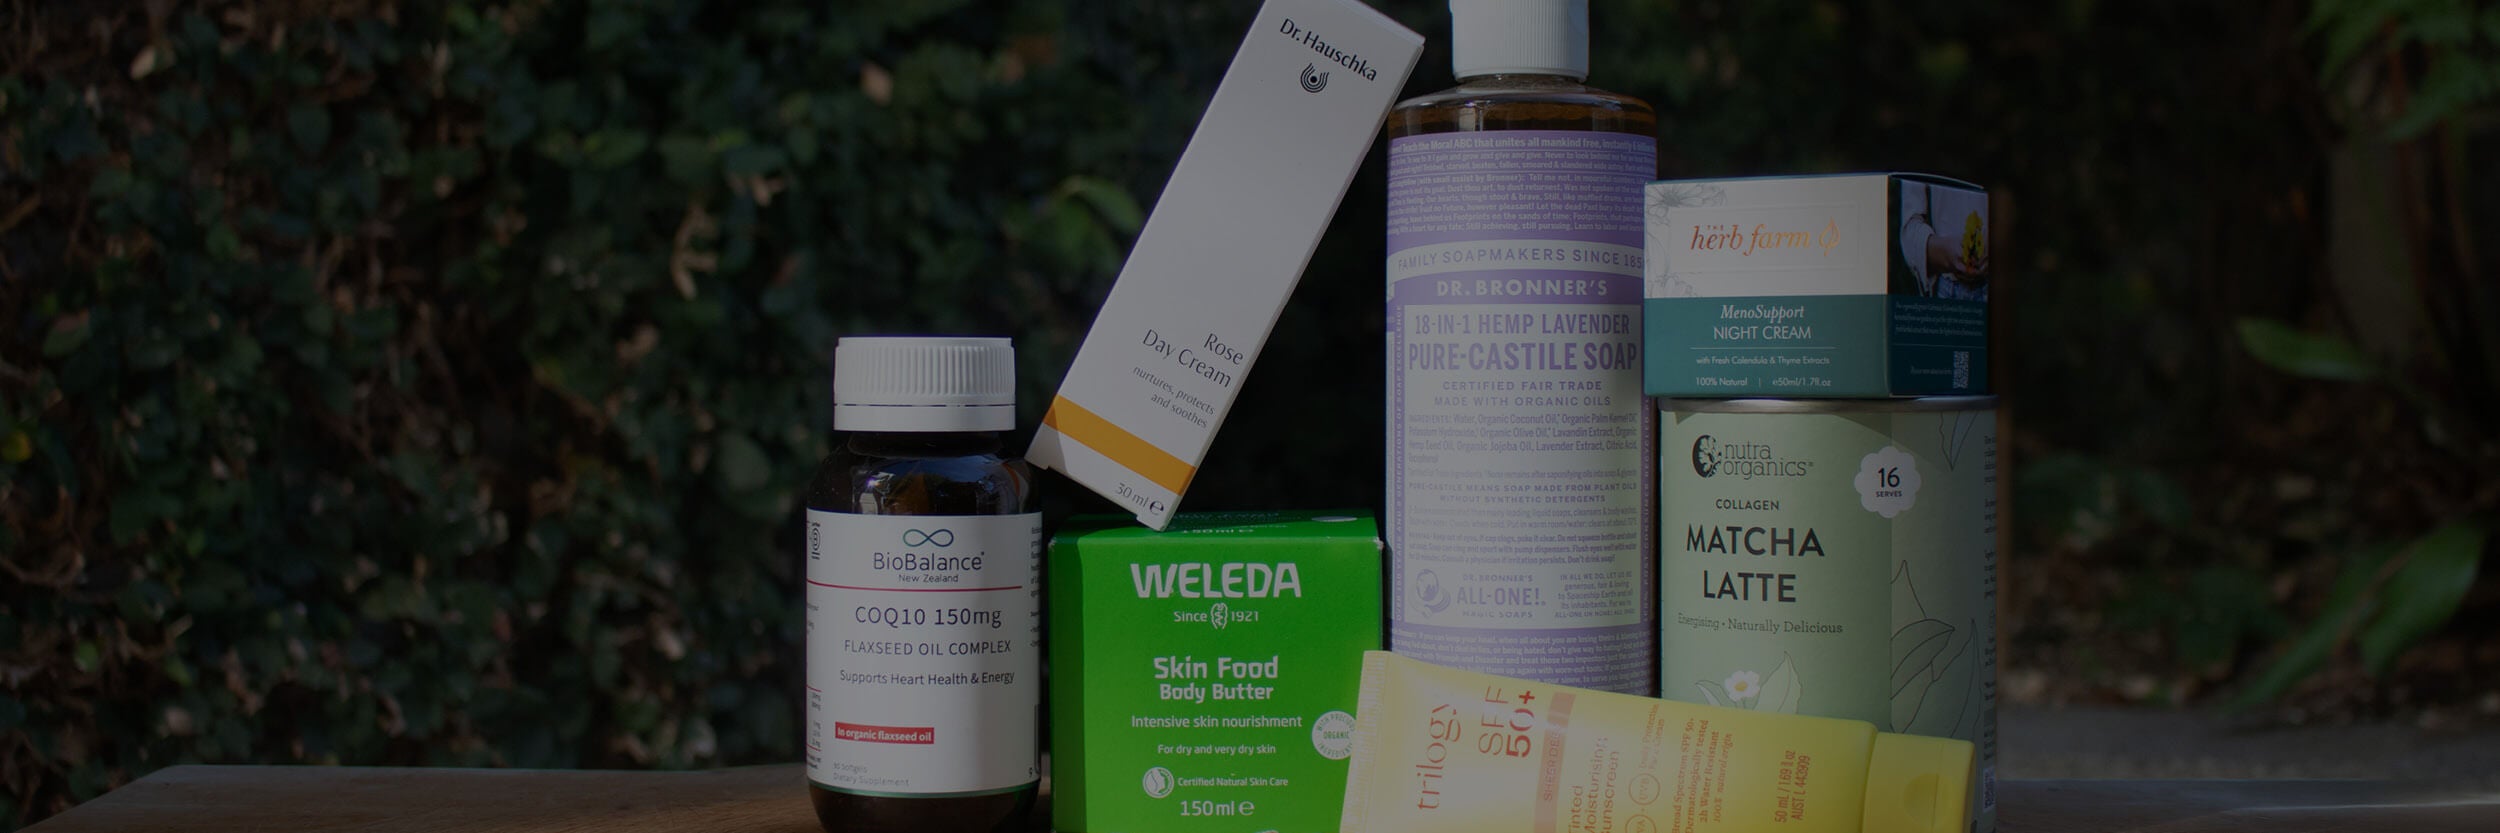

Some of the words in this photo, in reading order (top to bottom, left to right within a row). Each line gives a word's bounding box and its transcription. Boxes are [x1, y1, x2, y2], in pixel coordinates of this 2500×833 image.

[1280, 18, 1300, 41] Dr.
[1303, 31, 1377, 81] Hauschka
[1690, 224, 1744, 250] herb
[1742, 223, 1811, 256] farm
[1398, 252, 1438, 271] FAMILY
[1442, 248, 1566, 264] SOAPMAKERS
[1572, 249, 1619, 265] SINCE
[1624, 253, 1643, 269] 185
[1436, 280, 1470, 297] DR.
[1720, 304, 1804, 324] MenoSupport
[1415, 314, 1471, 335] 18-IN-1
[1479, 314, 1534, 335] HEMP
[1542, 314, 1631, 335] LAVENDER
[1713, 326, 1758, 341] NIGHT
[1762, 326, 1812, 341] CREAM
[1143, 329, 1176, 360] Day
[1178, 348, 1232, 388] Cream
[1203, 333, 1244, 366] Rose
[1409, 342, 1578, 371] PURE-CASTILE
[1583, 342, 1638, 371] SOAP
[1711, 356, 1730, 365] Fresh
[1132, 365, 1174, 395] nurtures,
[1176, 389, 1216, 416] protects
[1442, 381, 1514, 391] CERTIFIED
[1521, 381, 1553, 391] FAIR
[1558, 381, 1603, 391] TRADE
[1696, 377, 1717, 387] 100%
[1719, 377, 1748, 387] Natural
[1151, 393, 1171, 409] and
[1171, 404, 1207, 429] soothes
[1434, 396, 1469, 407] MADE
[1473, 396, 1509, 407] WITH
[1514, 396, 1579, 407] ORGANIC
[1583, 396, 1612, 407] OILS
[1724, 440, 1773, 460] nutra
[1723, 457, 1808, 480] organics
[1878, 467, 1901, 488] 16
[1116, 481, 1133, 498] 30
[1534, 484, 1562, 492] MADE
[1565, 484, 1591, 492] FROM
[1876, 490, 1903, 498] SERVES
[1715, 498, 1781, 511] COLLAGEN
[1686, 523, 1826, 557] MATCHA
[875, 551, 983, 572] BioBalance
[898, 573, 920, 584] New
[922, 573, 959, 584] Zealand
[1130, 562, 1303, 599] WELEDA
[1703, 570, 1797, 603] LATTE
[855, 606, 926, 628] COQ10
[934, 608, 1002, 629] 150mg
[1173, 610, 1209, 622] Since
[1231, 611, 1260, 622] 1921
[1727, 617, 1780, 634] Naturally
[1783, 620, 1844, 634] Delicious
[844, 639, 913, 656] FLAXSEED
[919, 642, 944, 656] OIL
[948, 639, 1012, 656] COMPLEX
[1153, 655, 1208, 679] Skin
[1217, 655, 1280, 679] Food
[840, 668, 888, 685] Supports
[892, 674, 925, 686] Heart
[928, 673, 967, 686] Health
[970, 674, 979, 685] &
[981, 671, 1016, 685] Energy
[1160, 682, 1206, 704] Body
[1212, 683, 1275, 700] Butter
[1131, 715, 1191, 729] Intensive
[1193, 715, 1219, 729] skin
[1221, 715, 1304, 729] nourishment
[846, 728, 877, 741] organic
[877, 728, 918, 741] flaxseed
[919, 729, 932, 741] oil
[1157, 744, 1173, 755] For
[1175, 744, 1192, 757] dry
[1193, 744, 1213, 755] and
[1214, 746, 1236, 757] very
[1238, 744, 1254, 757] dry
[1256, 744, 1277, 755] skin
[858, 774, 910, 787] Supplement
[1177, 776, 1215, 787] Certified
[1215, 776, 1248, 787] Natural
[1249, 776, 1268, 787] Skin
[1268, 776, 1289, 787] Care
